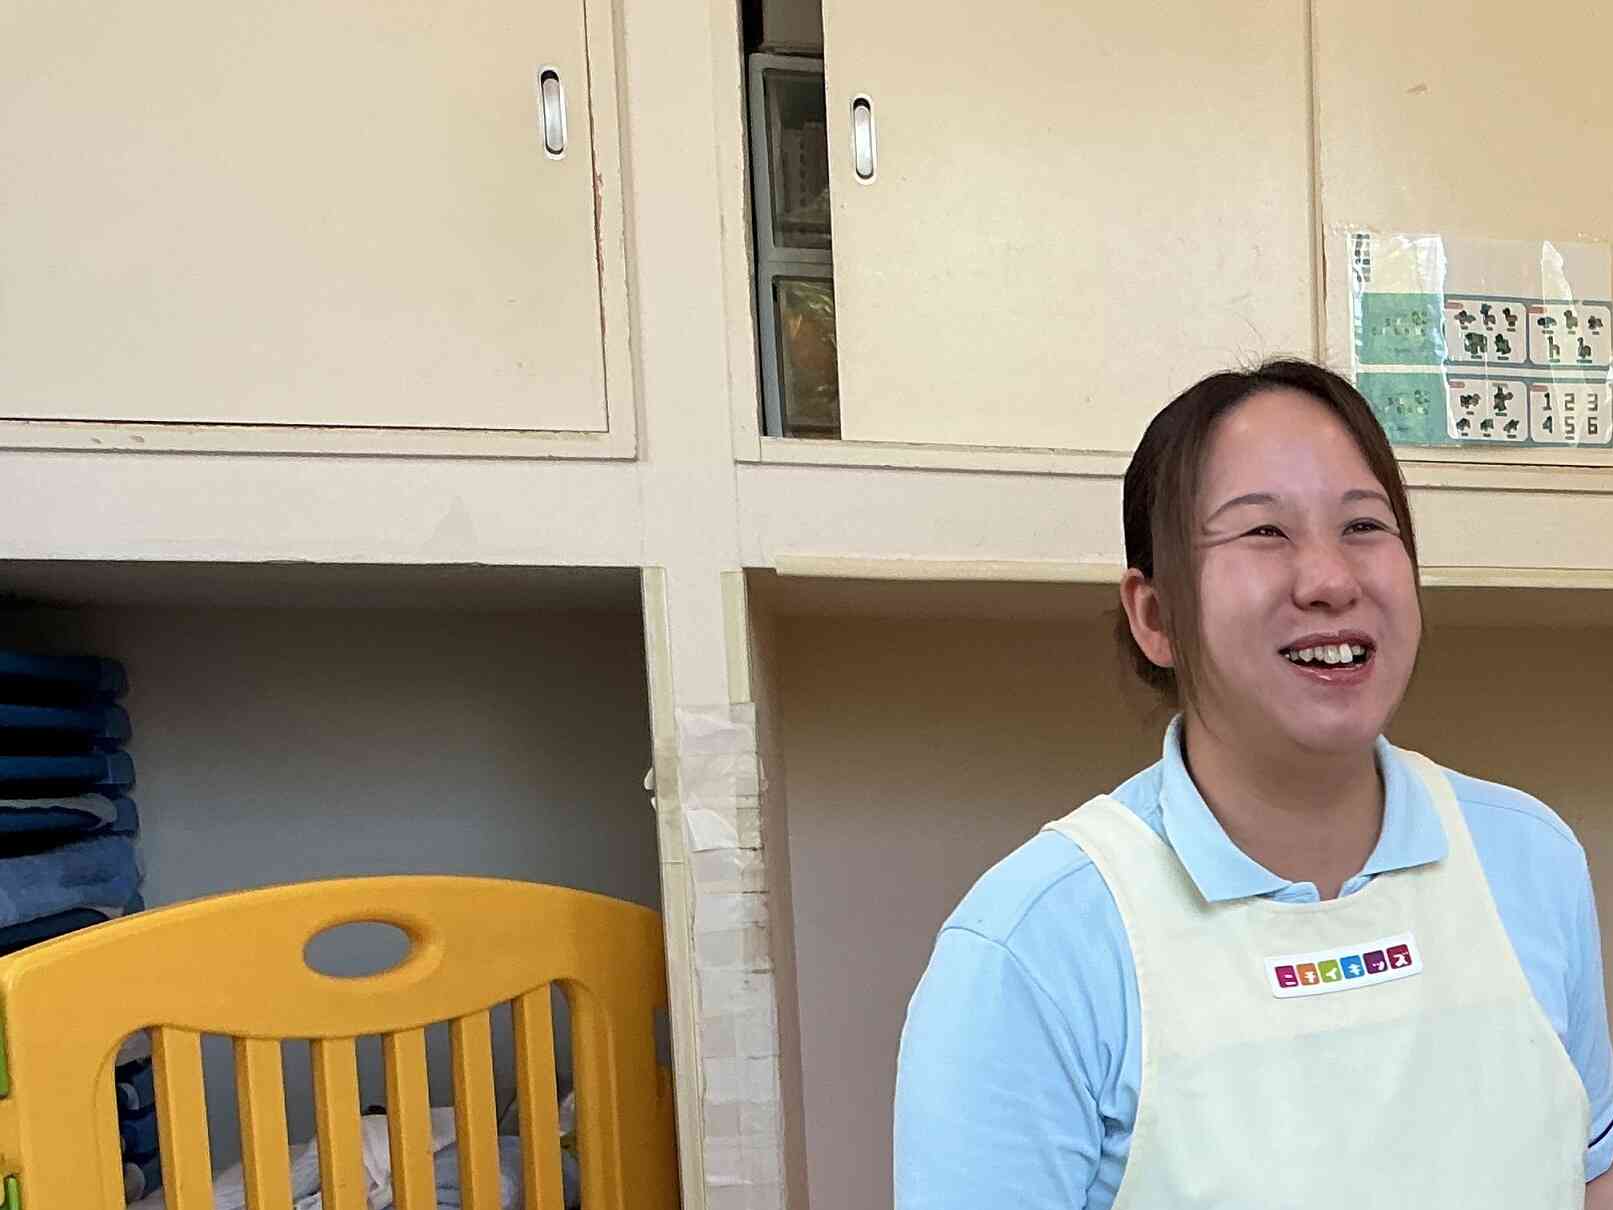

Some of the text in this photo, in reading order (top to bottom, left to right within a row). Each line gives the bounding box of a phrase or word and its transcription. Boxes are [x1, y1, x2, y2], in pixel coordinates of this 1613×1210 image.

[1542, 391, 1598, 412] 1 2 3
[1542, 415, 1598, 435] 4 5 6
[1282, 950, 1410, 986] ニチイキッズ
